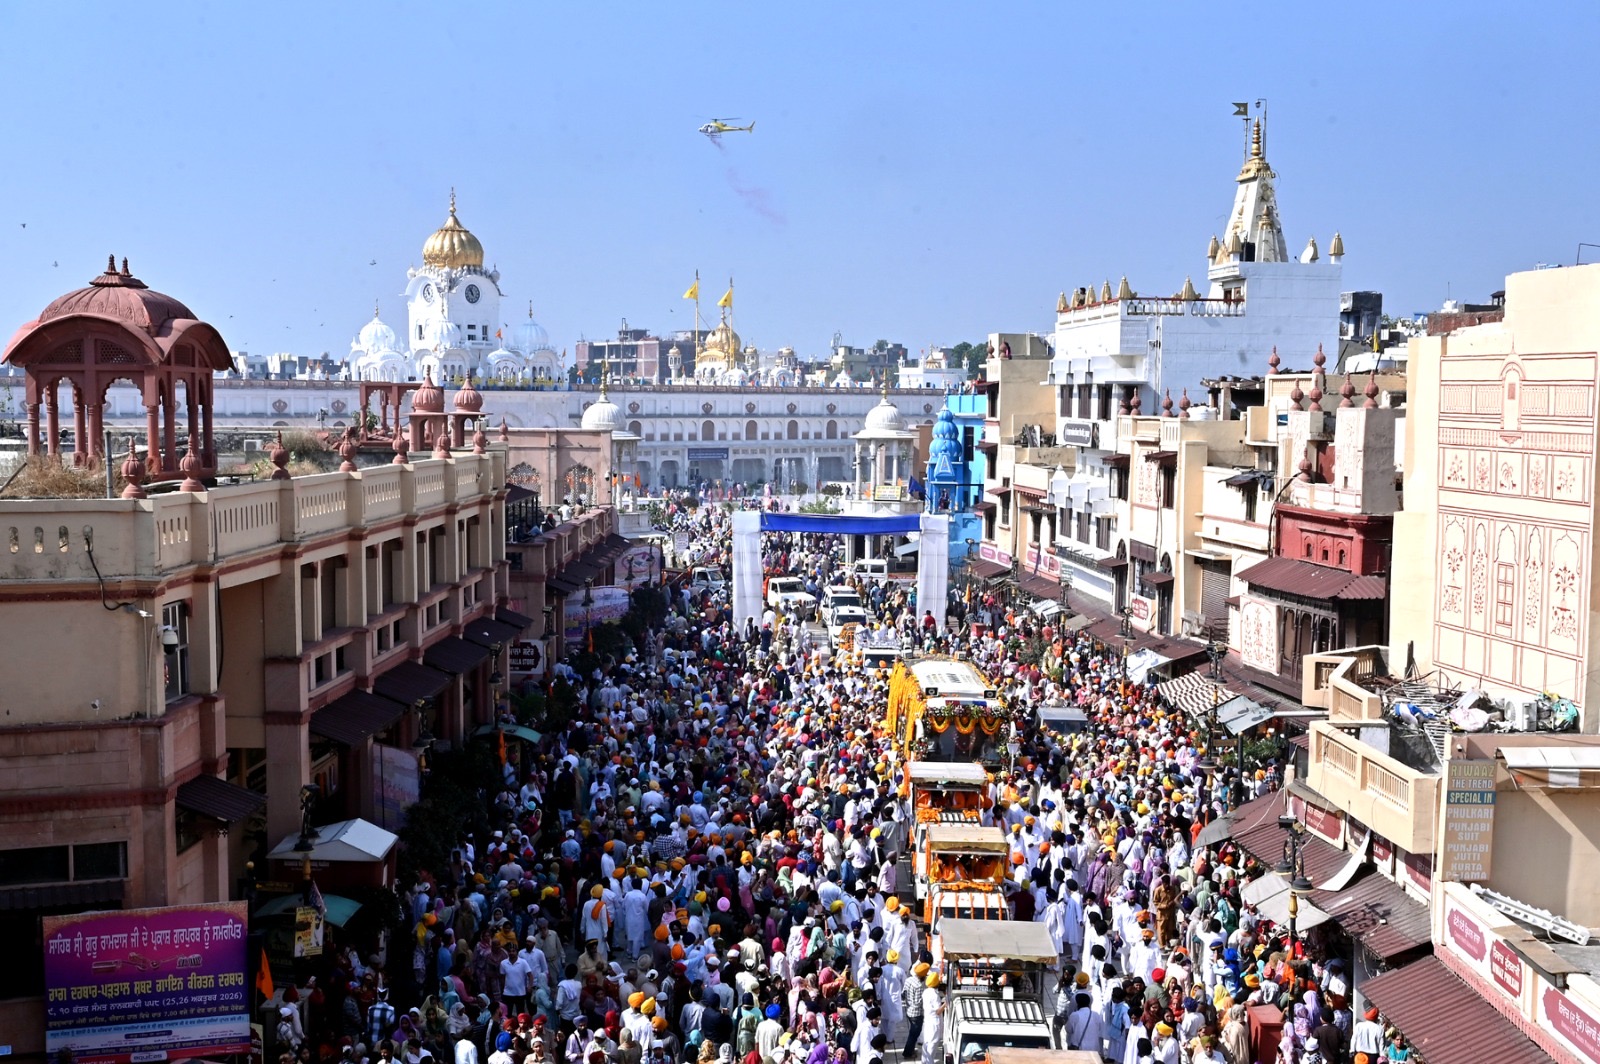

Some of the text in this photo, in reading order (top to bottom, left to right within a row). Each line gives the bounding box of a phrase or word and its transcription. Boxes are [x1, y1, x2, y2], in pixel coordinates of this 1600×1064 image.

[1450, 765, 1494, 777] RIWAAZ
[1451, 779, 1493, 789] THE TREND
[1450, 792, 1493, 803] SPECIAL IN
[1447, 808, 1494, 819] PHULKARI
[1448, 822, 1490, 832] PUNJABI
[1457, 832, 1480, 841] SUIT
[1447, 844, 1489, 853] PUNJABI
[1453, 852, 1481, 861] JUTTI
[1451, 863, 1482, 871] KURTA
[49, 933, 71, 954] ਸਾਹਿਬ
[74, 932, 83, 958] ਸ੍ਰੀ
[85, 936, 98, 958] ਗੁਰੂ
[100, 933, 128, 950] ਰਾਮਦਾਸ
[130, 927, 139, 948] ਜੀ
[142, 926, 148, 946] ਦੇ
[173, 927, 201, 948] ਗੁਰਪੁਰਬ
[212, 918, 242, 941] ਸਮਰਪਿਤ
[48, 988, 67, 1002] ਰਾਗ
[156, 974, 184, 992] ਗਾਇਨ
[187, 972, 214, 989] ਕੀਰਤਨ
[218, 972, 244, 987] ਦਰਬਾਰ
[162, 996, 189, 1006] (25,26
[219, 991, 242, 1001] 2026)
